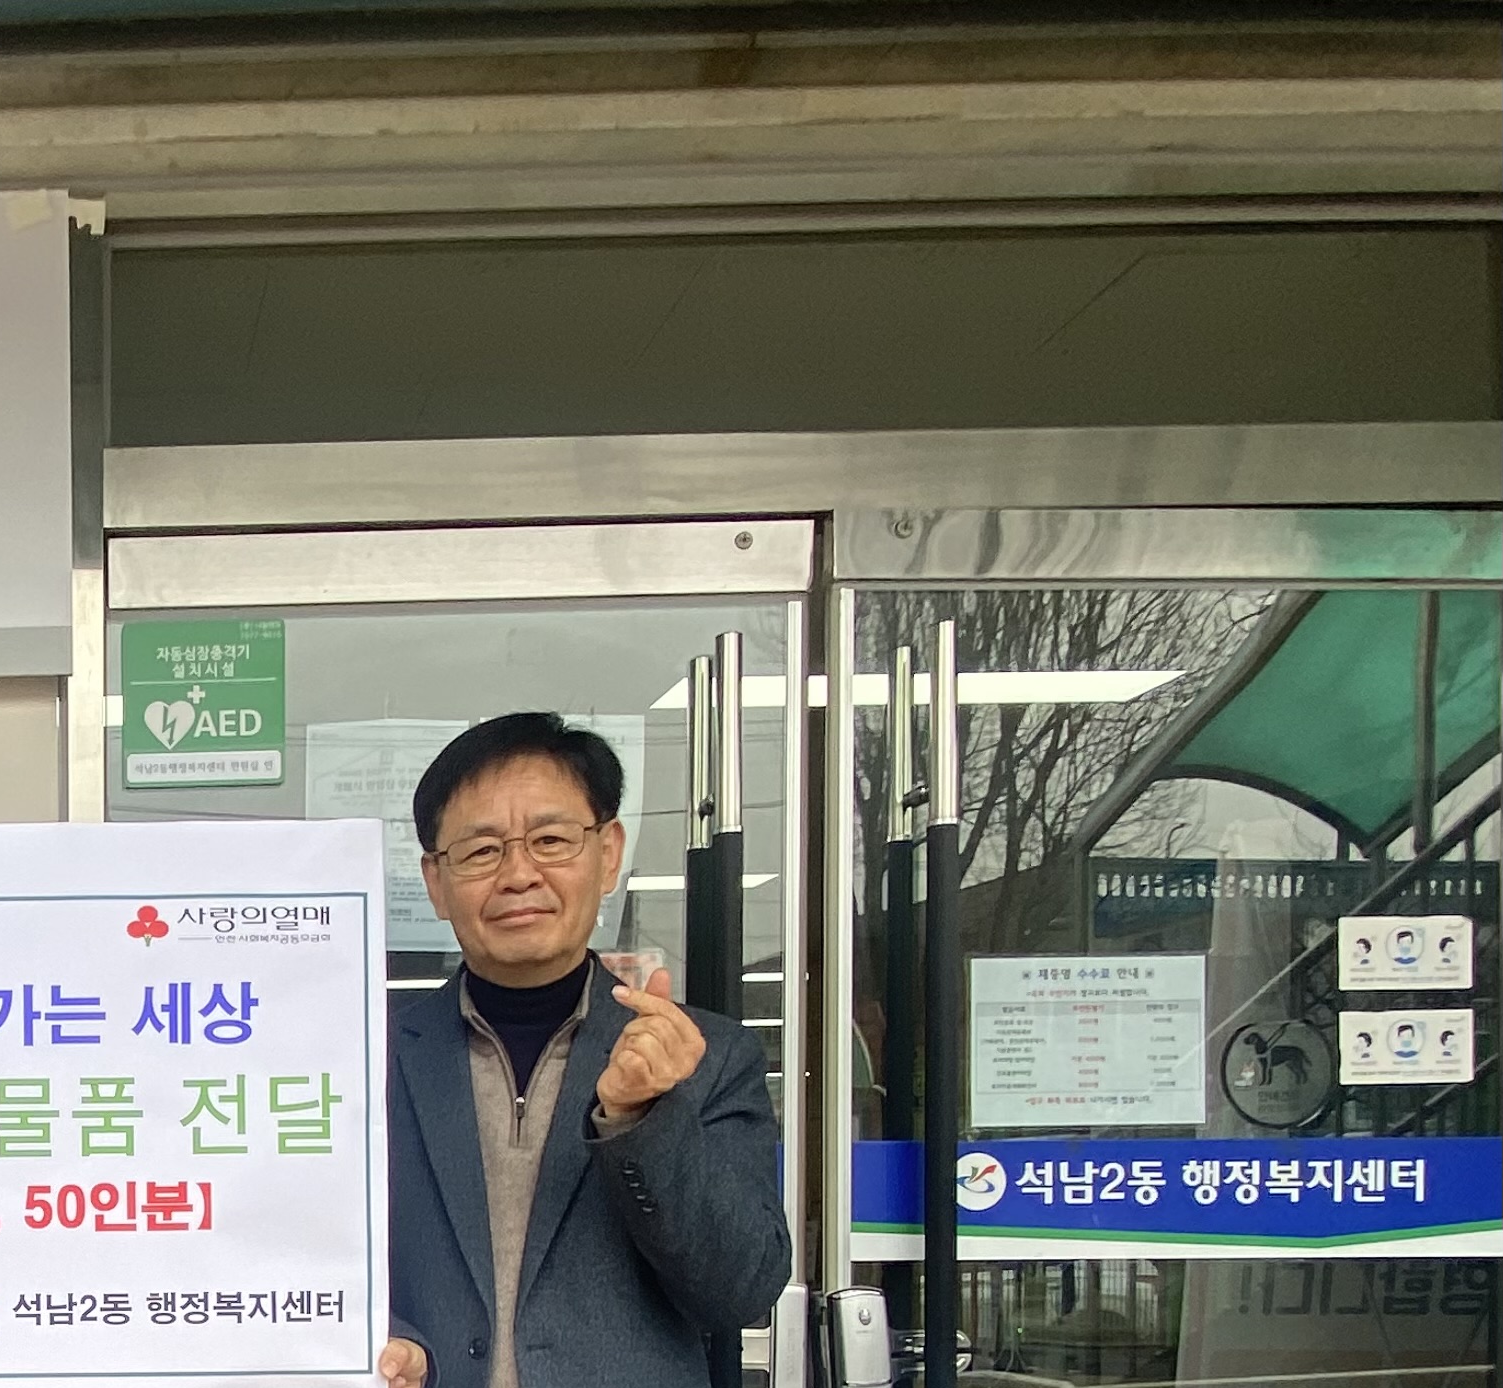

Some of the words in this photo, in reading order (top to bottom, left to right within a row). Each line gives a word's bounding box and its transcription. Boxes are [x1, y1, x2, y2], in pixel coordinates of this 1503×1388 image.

[156, 644, 250, 661] 자동심장충격기
[172, 662, 235, 678] 설치시설
[193, 708, 262, 737] AED
[177, 906, 331, 932] 사랑의열매
[133, 981, 260, 1046] 세상
[179, 1071, 343, 1157] 전달
[1015, 1160, 1166, 1205] 석남2동
[1182, 1158, 1427, 1204] 행정복지센터
[11, 1291, 133, 1325] 석남2동
[145, 1289, 344, 1326] 행정복지센터
